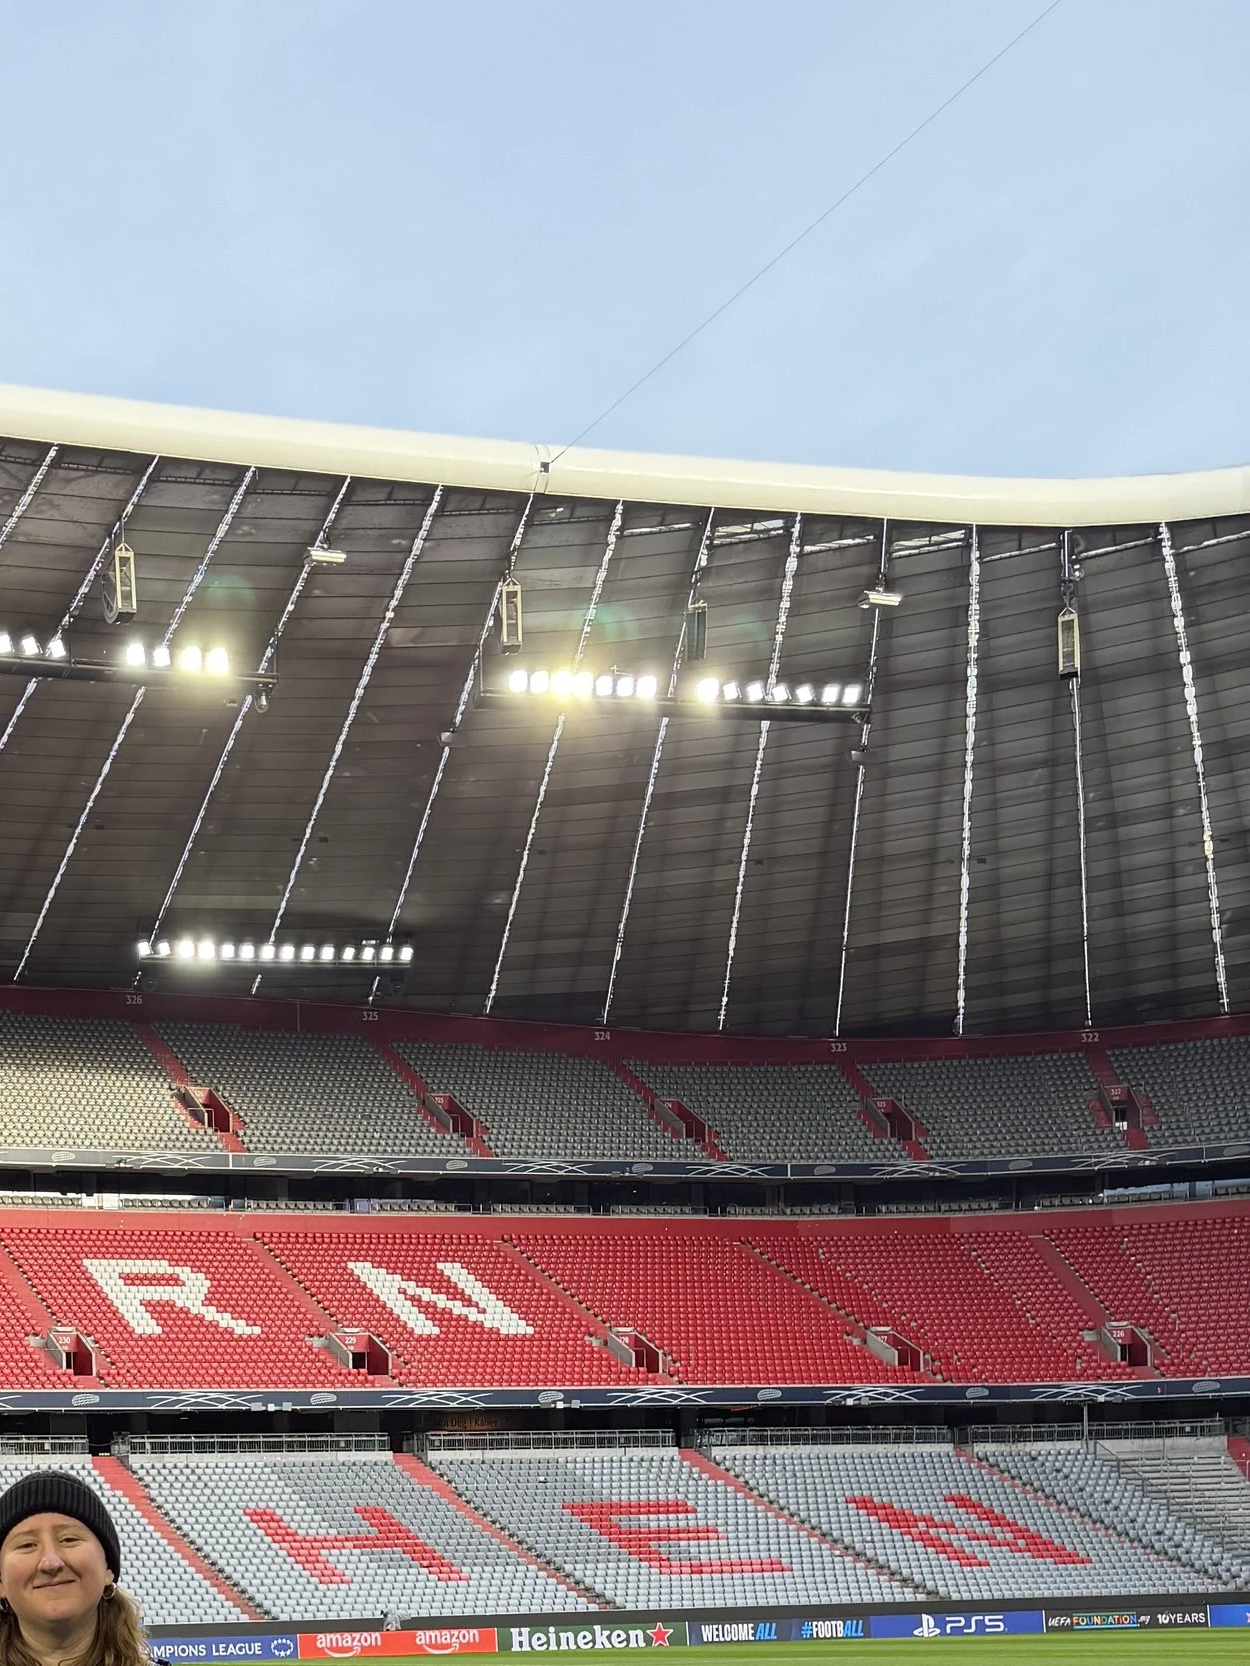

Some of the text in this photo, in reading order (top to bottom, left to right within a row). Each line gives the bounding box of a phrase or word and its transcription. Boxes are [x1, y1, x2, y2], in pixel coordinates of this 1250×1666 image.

[126, 995, 143, 1005] 326
[362, 1011, 379, 1021] 325
[594, 1031, 611, 1041] 324
[1081, 1032, 1099, 1043] 322
[830, 1042, 847, 1052] 323
[1112, 1330, 1125, 1338] 226
[58, 1336, 71, 1344] 230
[344, 1336, 357, 1344] 229
[945, 1615, 1005, 1634] PS5
[1048, 1616, 1072, 1627] UEFA
[701, 1622, 778, 1642] WELCOME ALL
[801, 1619, 864, 1639] #FOOTBALL
[316, 1631, 382, 1648] amazon
[415, 1628, 479, 1645] amazon
[510, 1624, 646, 1652] Heineken
[151, 1642, 262, 1659] MPIONS LEAGUE
